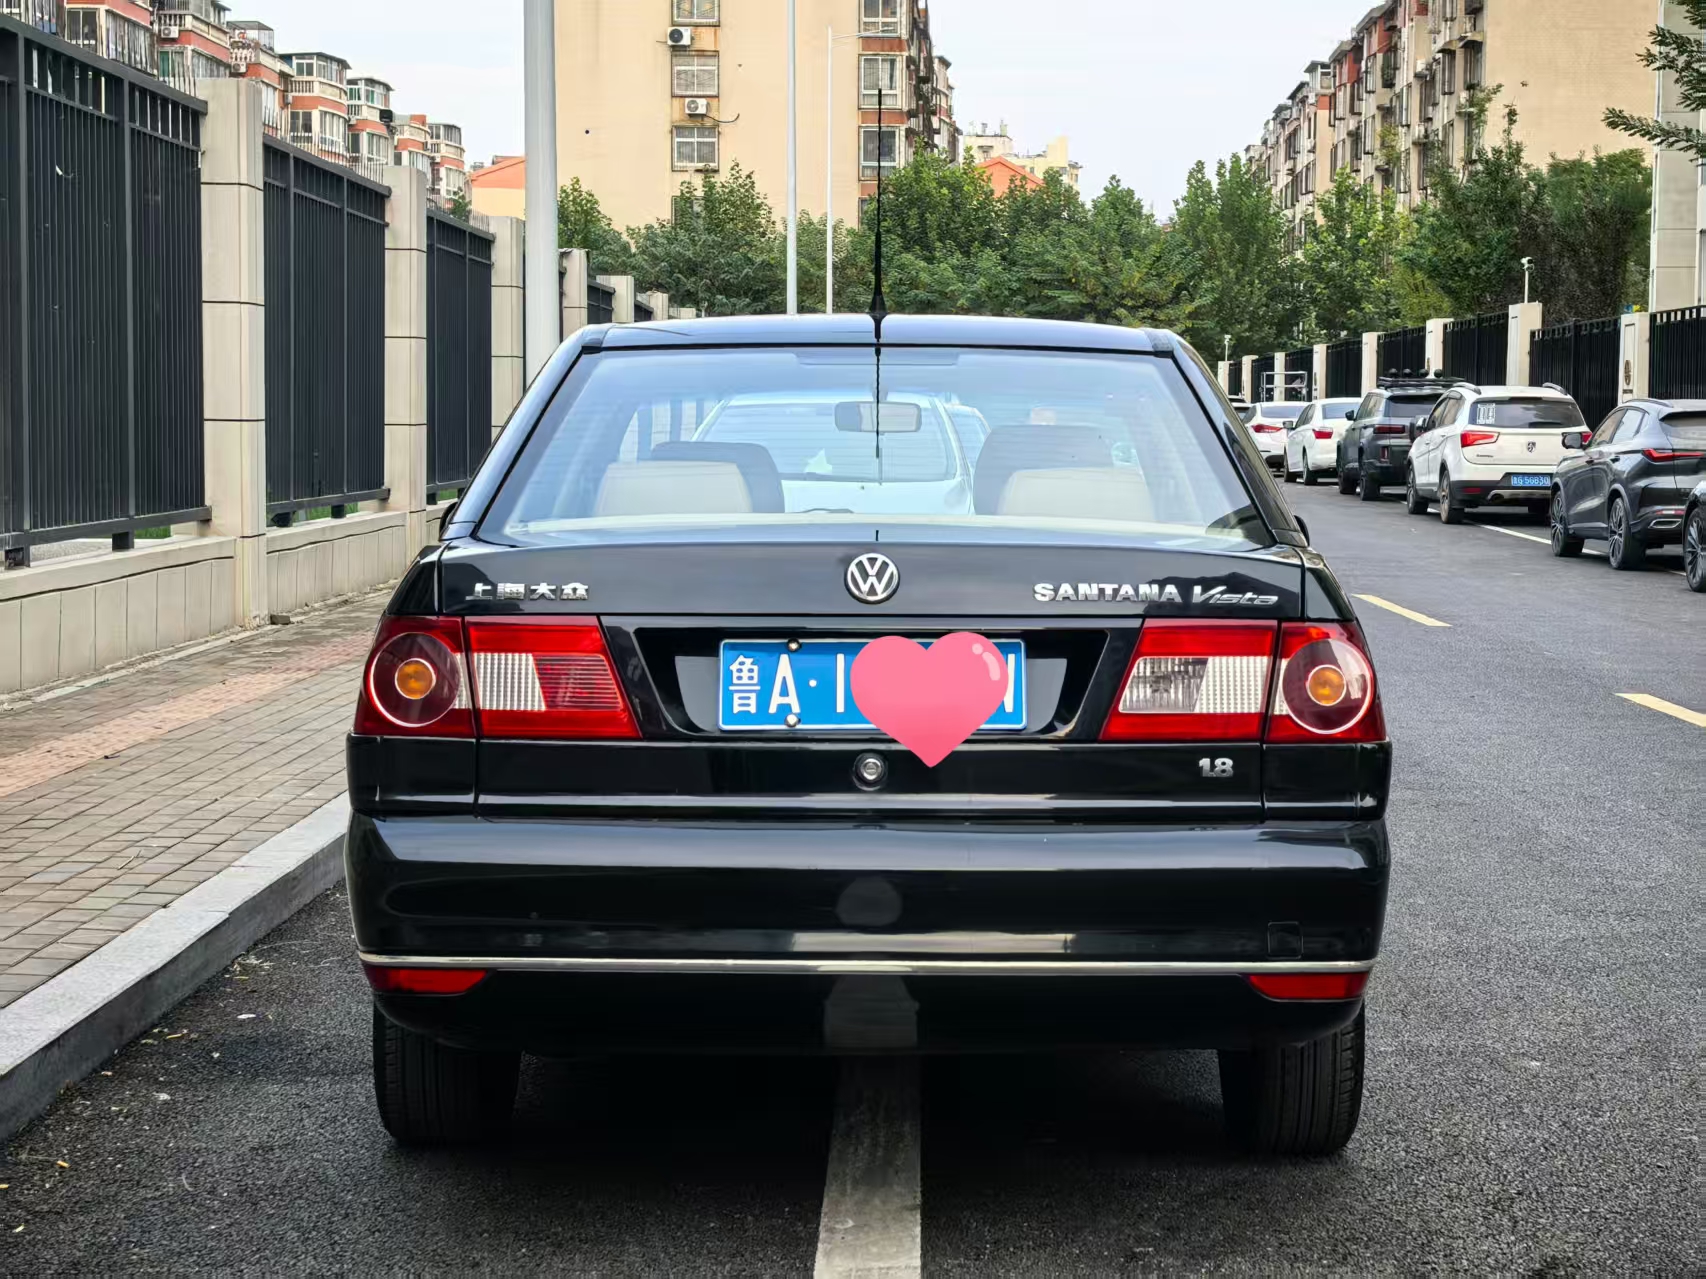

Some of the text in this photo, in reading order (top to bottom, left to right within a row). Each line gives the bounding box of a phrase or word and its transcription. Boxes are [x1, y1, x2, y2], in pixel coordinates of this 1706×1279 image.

[465, 582, 588, 601] 上海大众
[1033, 582, 1278, 606] SANTANA Vista
